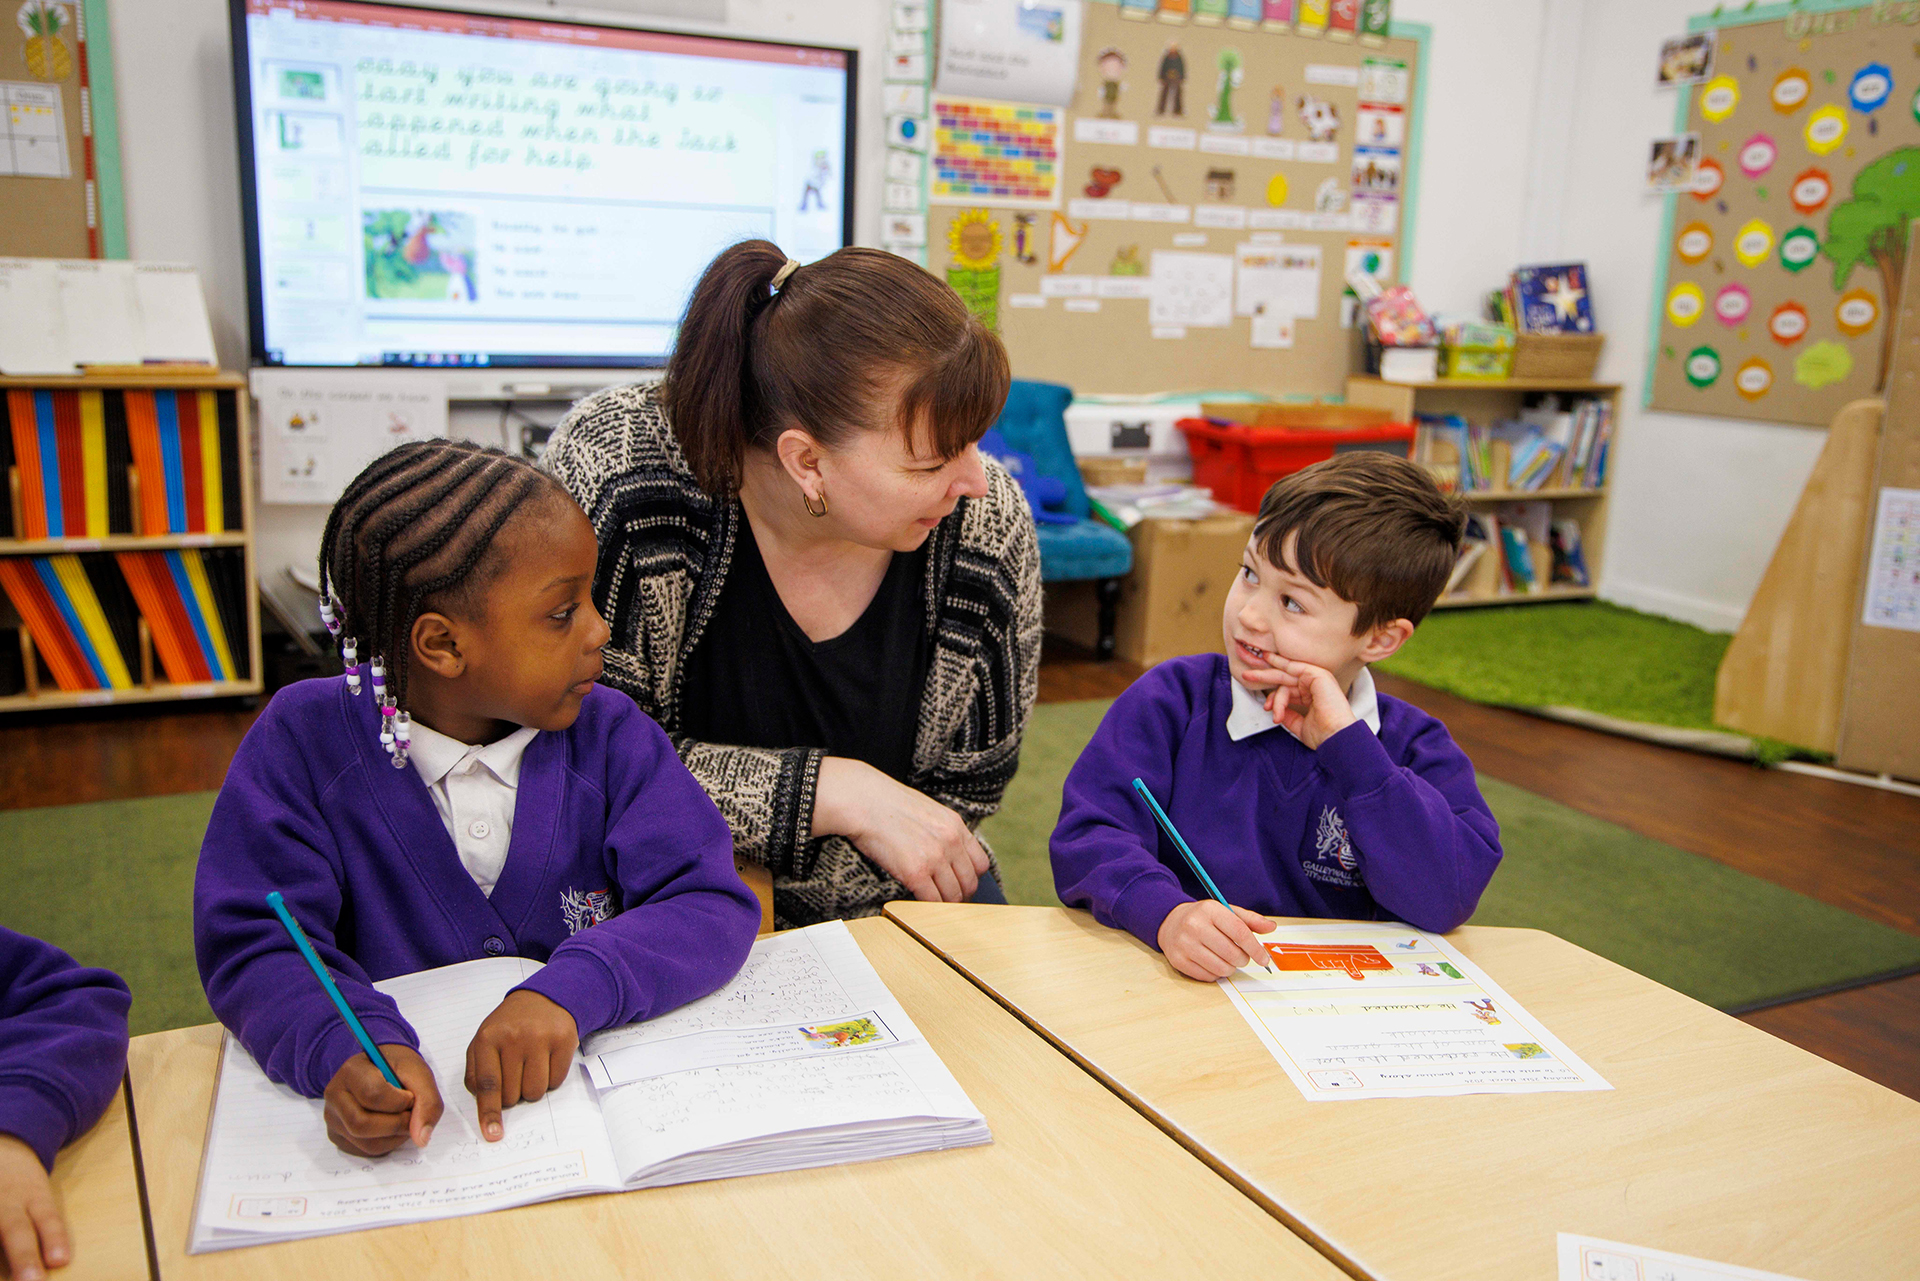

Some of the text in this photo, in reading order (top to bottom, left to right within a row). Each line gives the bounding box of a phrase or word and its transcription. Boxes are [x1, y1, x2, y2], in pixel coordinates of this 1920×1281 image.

[444, 91, 560, 120] writing
[576, 102, 651, 122] what
[520, 120, 598, 143] when
[615, 125, 660, 149] the
[466, 138, 511, 170] for
